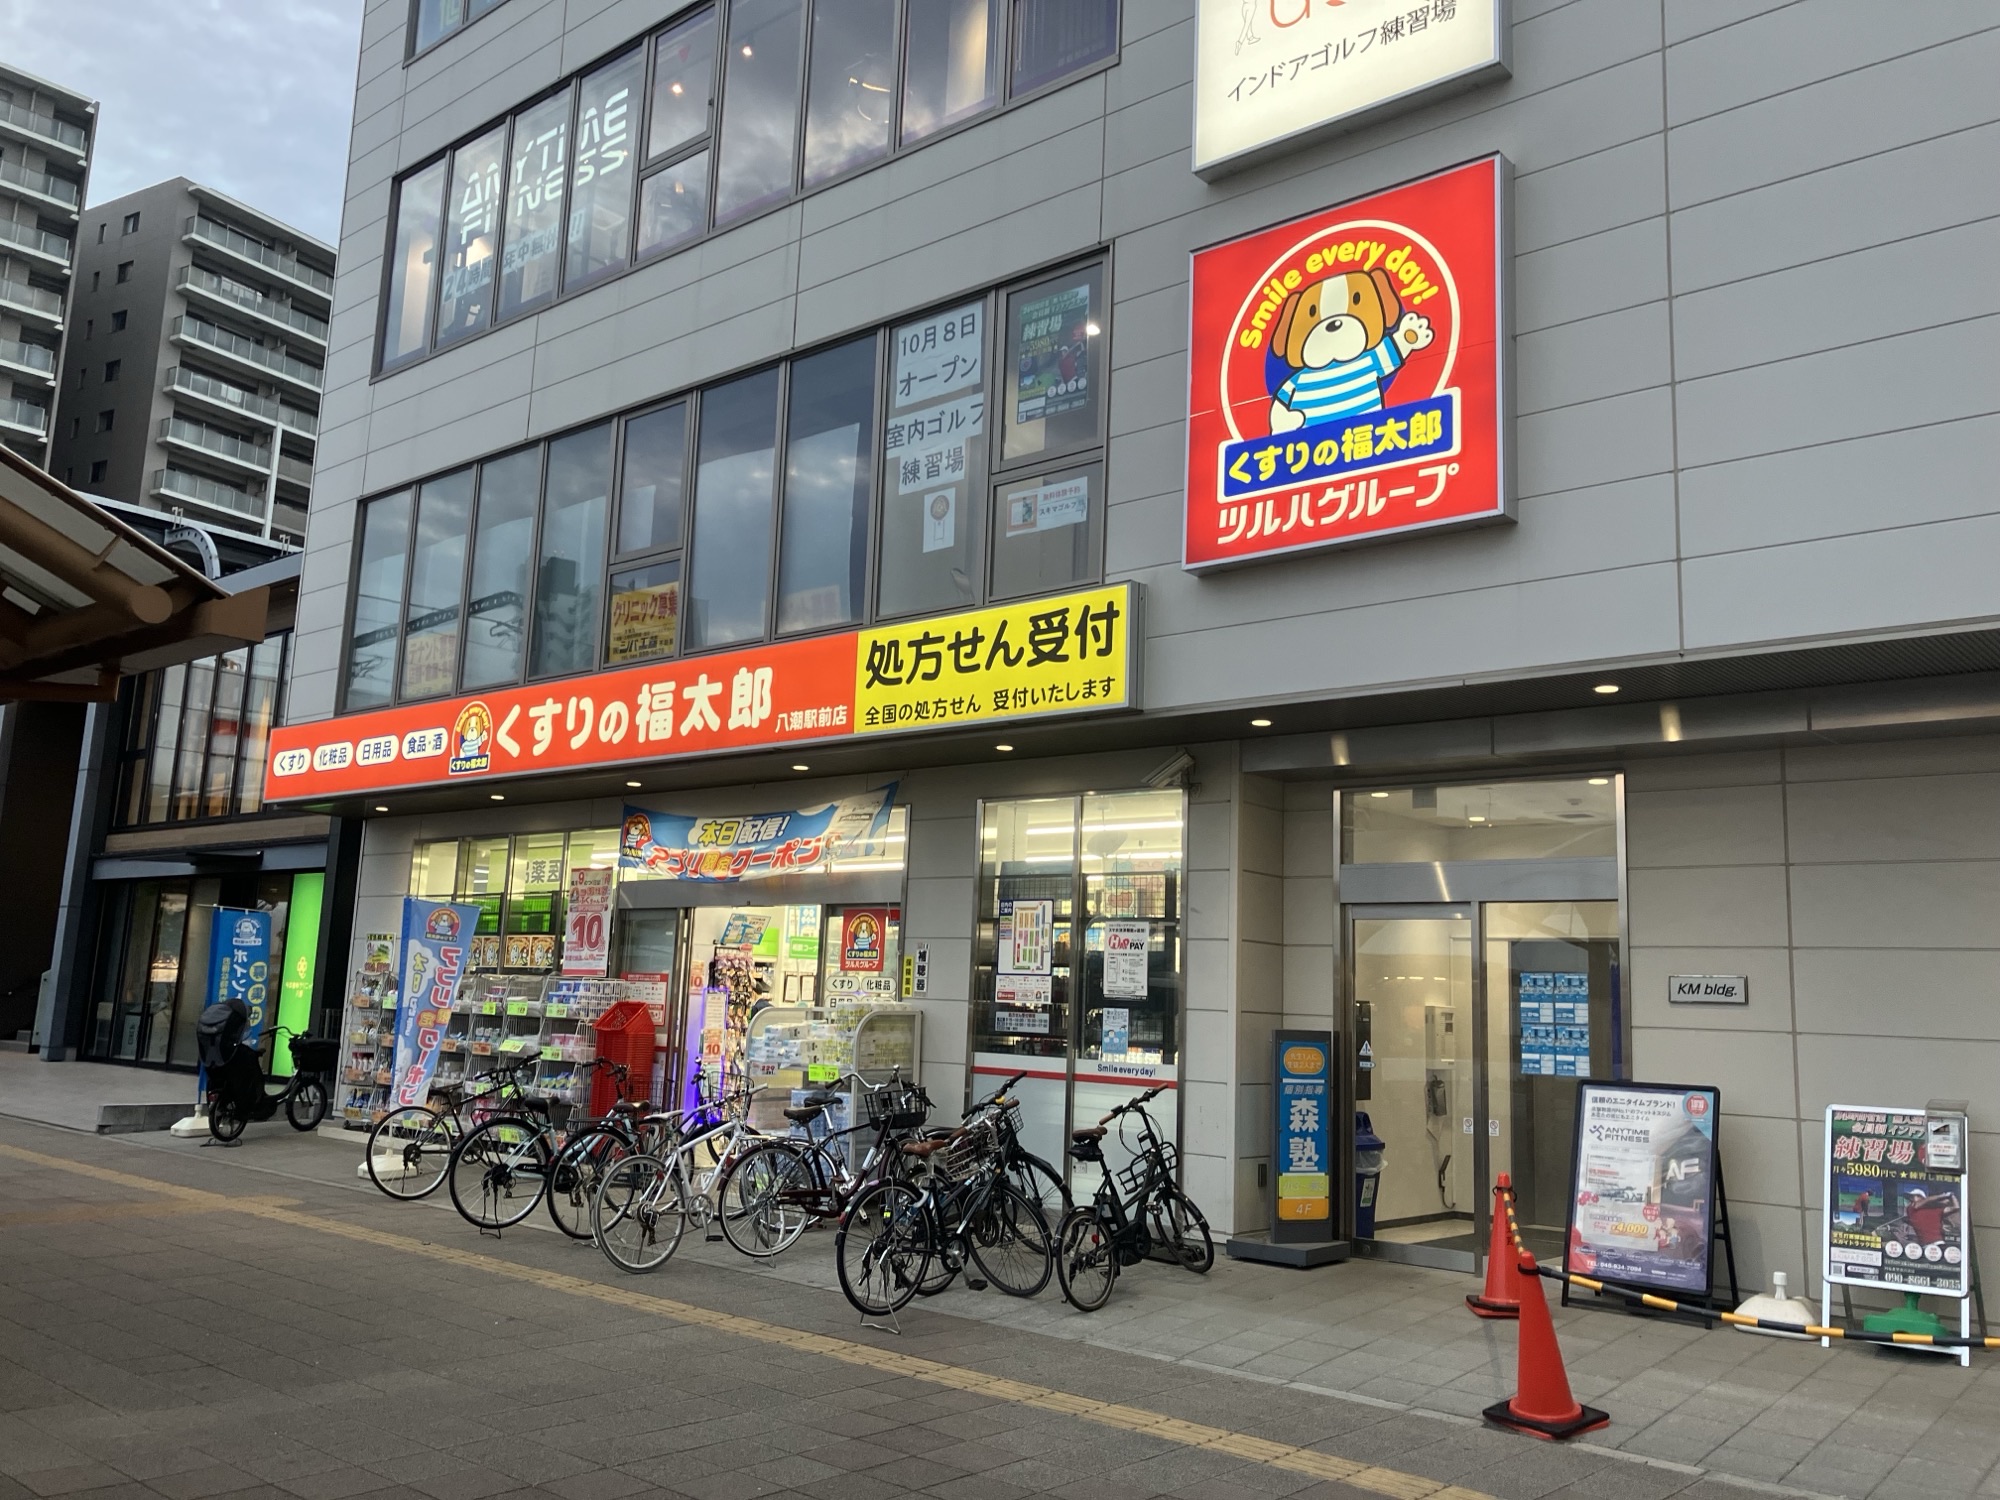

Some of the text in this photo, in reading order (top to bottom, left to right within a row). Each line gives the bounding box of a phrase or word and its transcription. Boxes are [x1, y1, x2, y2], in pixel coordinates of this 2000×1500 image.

[1228, 1, 1457, 101] インドアゴルフ練習場
[1240, 240, 1439, 349] Smile every day!
[900, 313, 975, 356] 10月8日
[899, 355, 977, 397] オープン
[887, 402, 984, 450] 室内ゴルフ
[1229, 410, 1443, 484] くすりの福太郎
[902, 445, 964, 486] 練習場
[1040, 502, 1077, 516] スキマゴルフ
[1217, 463, 1459, 544] ツルハグループ
[866, 601, 1120, 690] 処方せん受付
[865, 676, 1115, 725] 全国の処方せん 受付いたします
[496, 666, 773, 758] くすりの福太郎
[775, 705, 848, 733] 八潮駅前店
[362, 740, 391, 759] 日用品
[407, 733, 443, 755] 食品・酒
[279, 753, 305, 772] くすり
[319, 747, 347, 766] 化粧品
[451, 757, 487, 771] くすりの福太郎
[700, 815, 791, 847] 本日配信!
[1130, 942, 1144, 950] PAY
[832, 980, 853, 989] くすり
[867, 980, 890, 990] 化粧品
[1677, 983, 1738, 997] KM bldg.
[1098, 1064, 1156, 1077] Smile every day!
[1284, 1085, 1324, 1095] 個別指導
[1289, 1098, 1319, 1172] 森塾
[1605, 1127, 1650, 1136] ANYTIME
[1605, 1134, 1650, 1143] FITNESS
[1834, 1136, 1915, 1165] 練習場
[1666, 1158, 1699, 1180] AF
[1833, 1162, 1897, 1178] 月々5980円で
[1296, 1203, 1312, 1215] 4F
